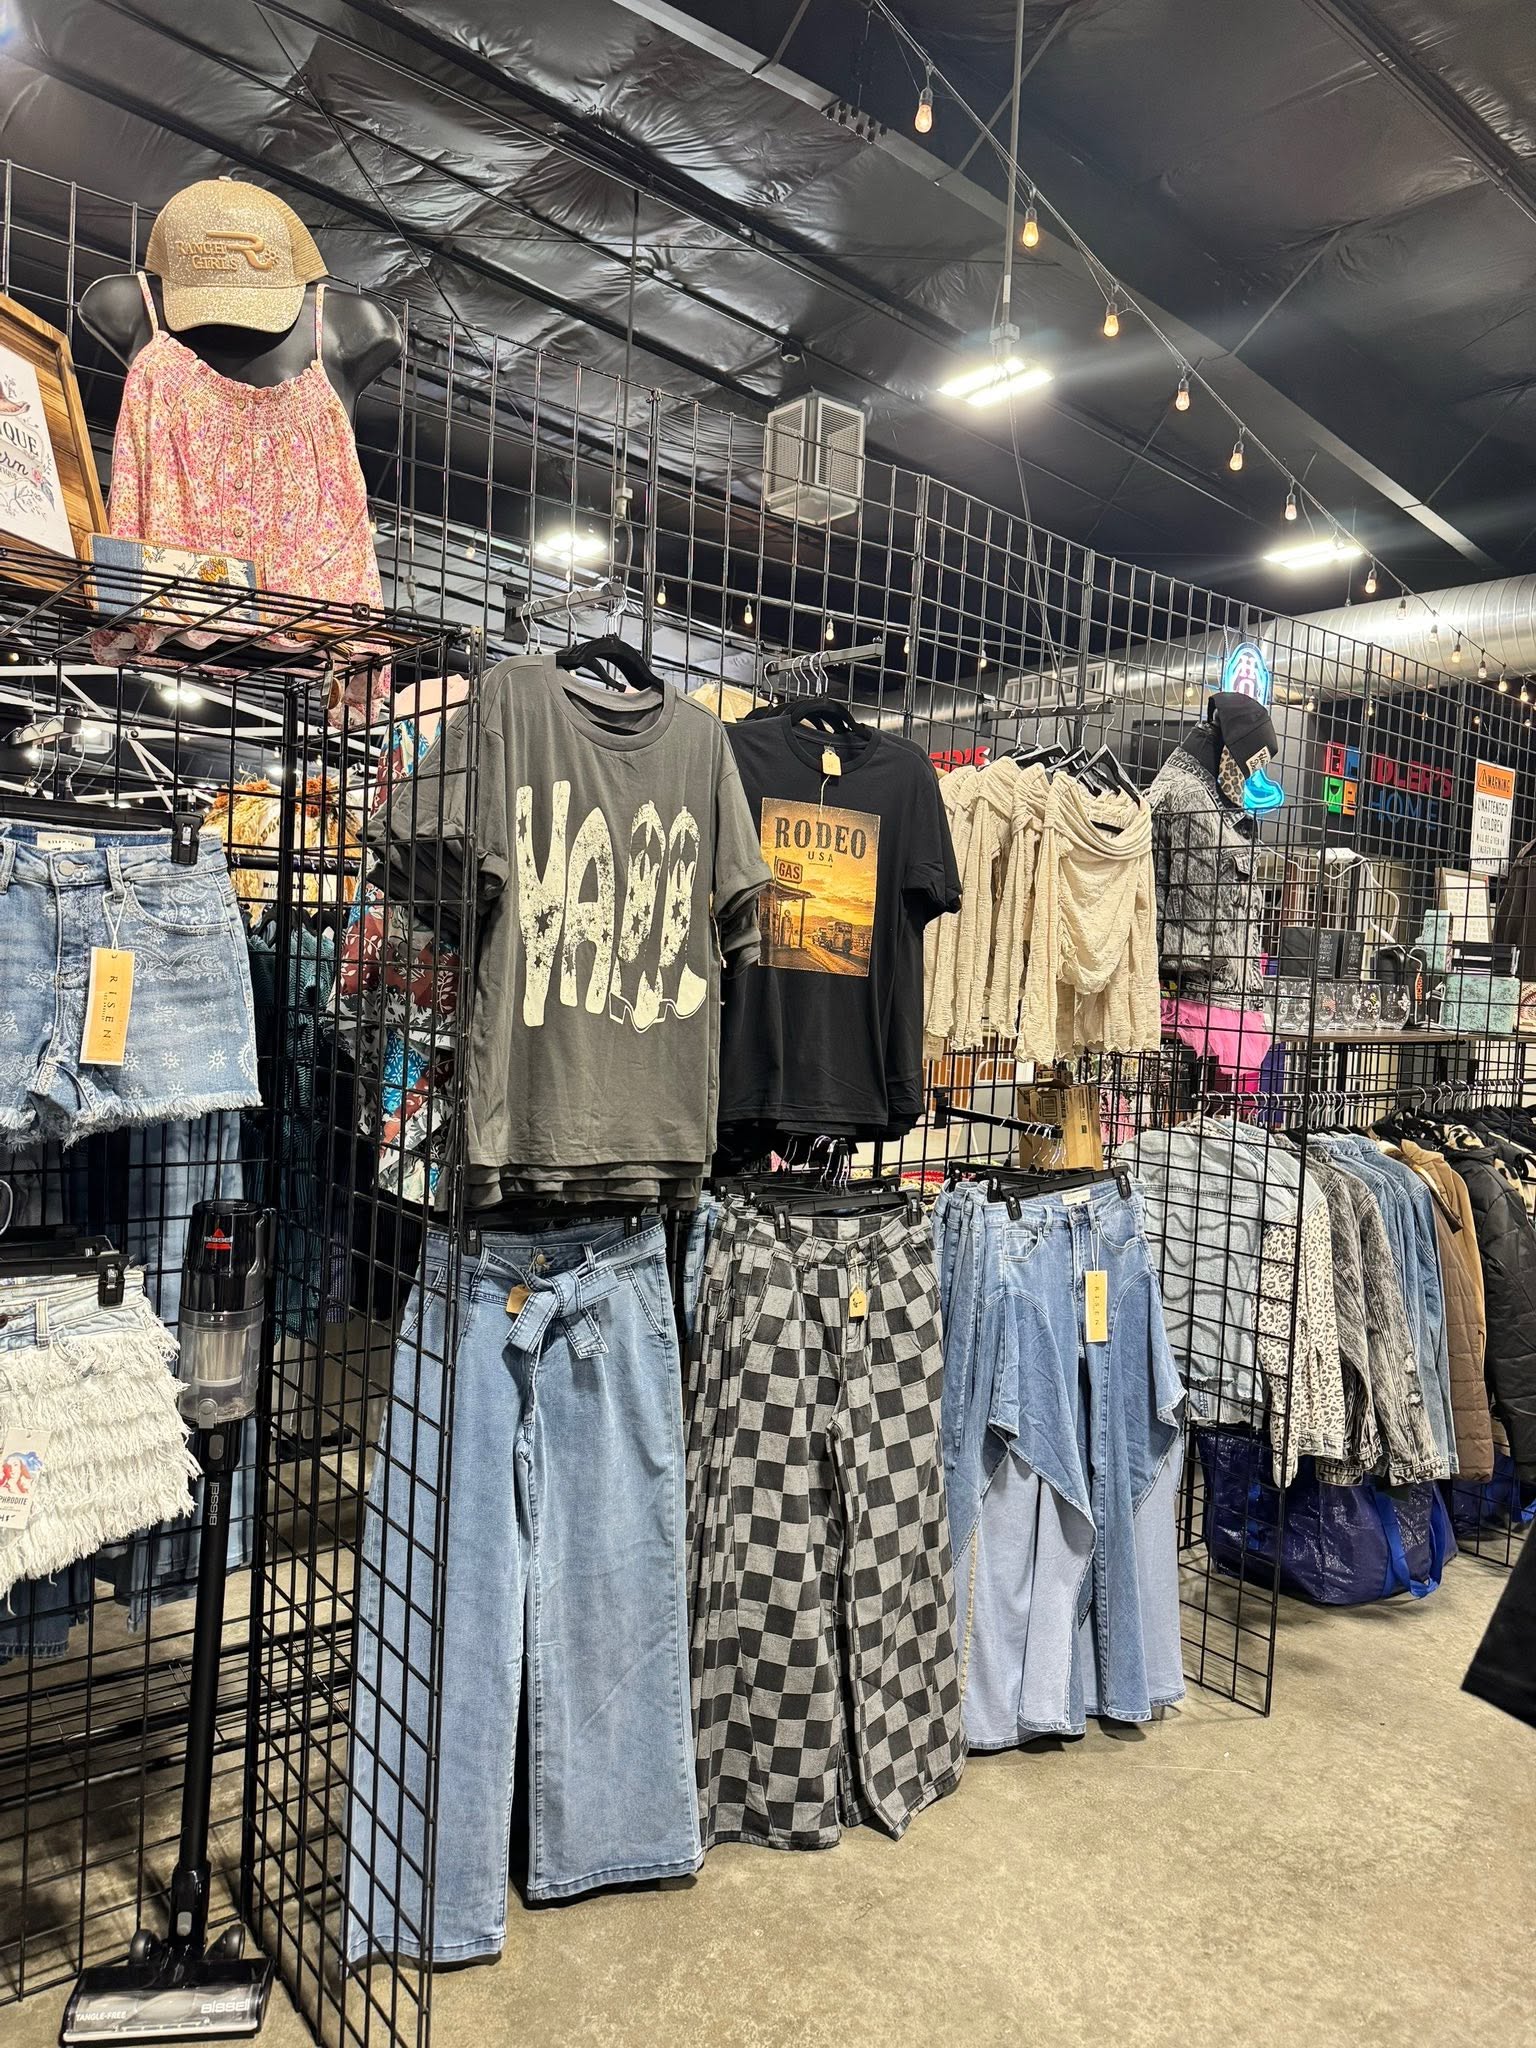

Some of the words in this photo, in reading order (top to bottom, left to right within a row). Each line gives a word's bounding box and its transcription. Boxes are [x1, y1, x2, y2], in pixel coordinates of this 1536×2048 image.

[192, 255, 238, 270] GIRLS
[0, 421, 39, 457] QUE
[1487, 774, 1511, 792] WARNING
[1368, 788, 1438, 830] HOME
[1477, 797, 1508, 817] UNATTENDED
[1480, 816, 1503, 833] CHILDREN
[774, 816, 867, 859] RODEO
[807, 851, 834, 863] USA
[778, 862, 800, 880] GAS
[103, 975, 118, 1039] RISEN
[76, 2011, 127, 2022] TANGLE-FREE
